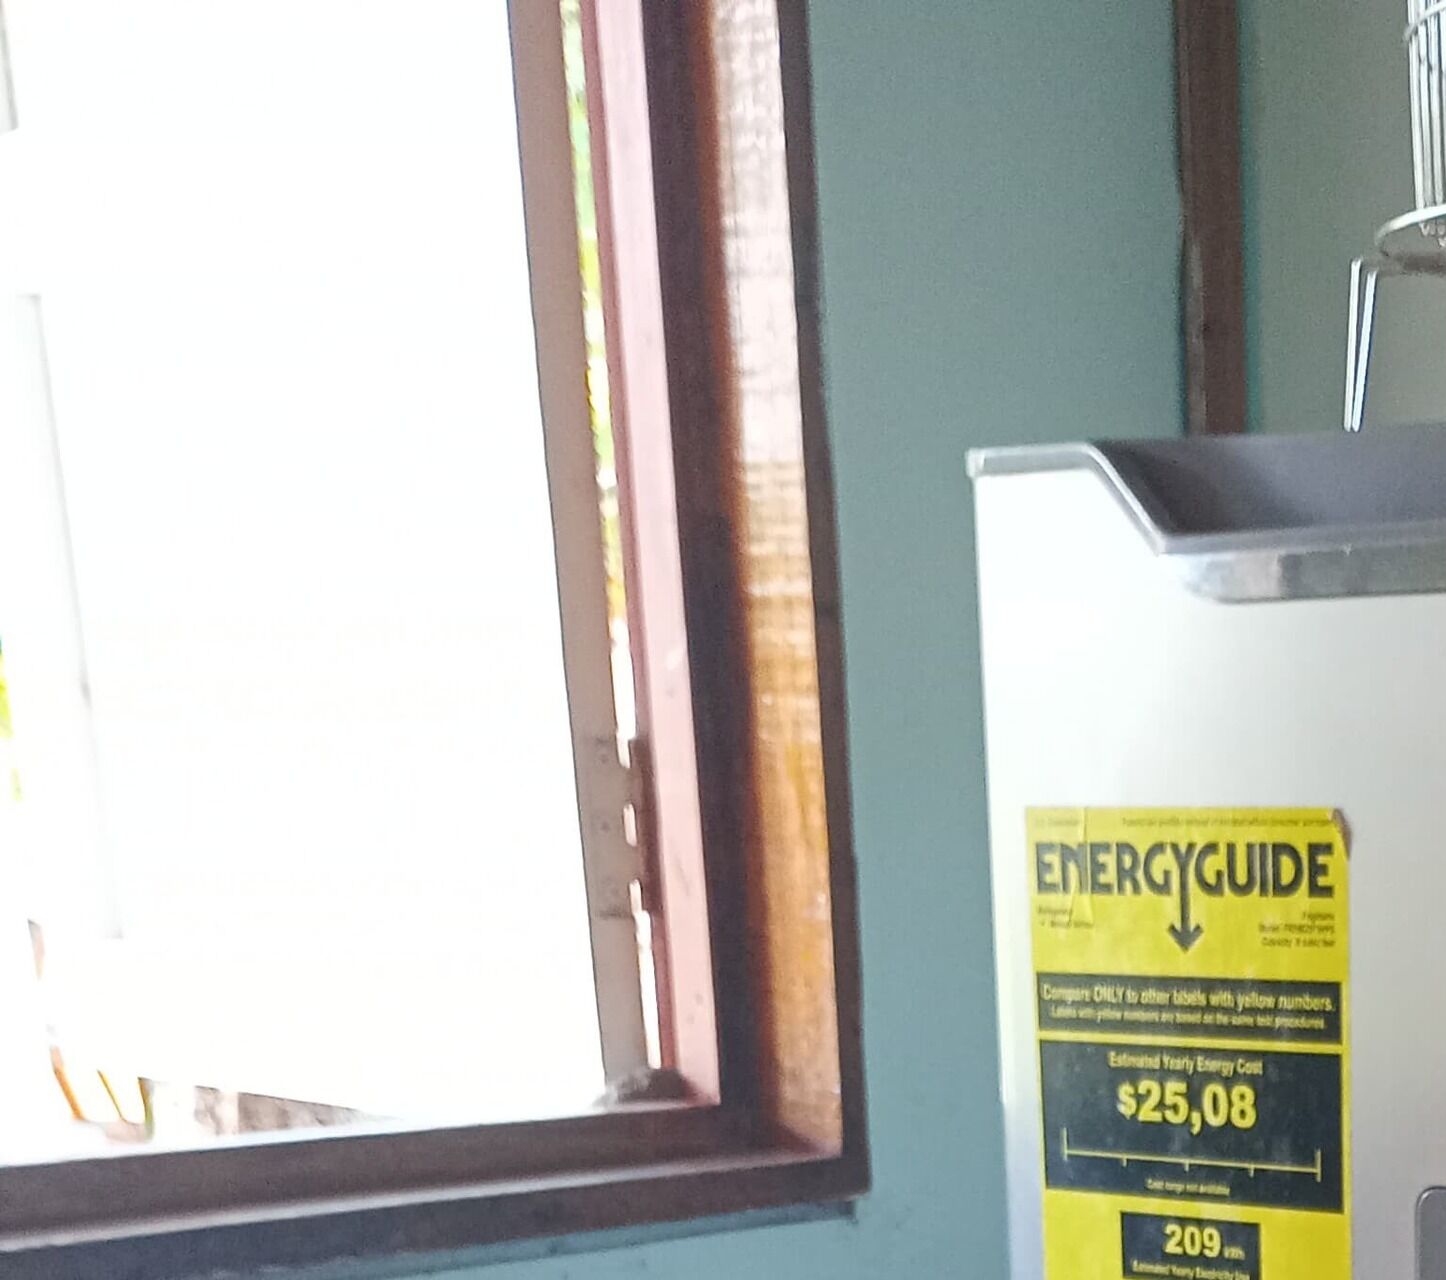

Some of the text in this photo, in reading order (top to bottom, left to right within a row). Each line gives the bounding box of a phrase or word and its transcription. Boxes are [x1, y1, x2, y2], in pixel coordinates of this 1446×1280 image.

[1035, 841, 1335, 898] ENERGYGUIDE
[1043, 983, 1090, 1004] Compare
[1093, 985, 1125, 1003] ONLY
[1126, 988, 1139, 1003] to
[1140, 988, 1171, 1005] other
[1208, 990, 1235, 1007] with
[1236, 991, 1276, 1012] yellow
[1108, 1051, 1263, 1077] Estimated Yearly Energy Cost
[1117, 1079, 1257, 1135] $25,08
[1163, 1222, 1221, 1258] 209
